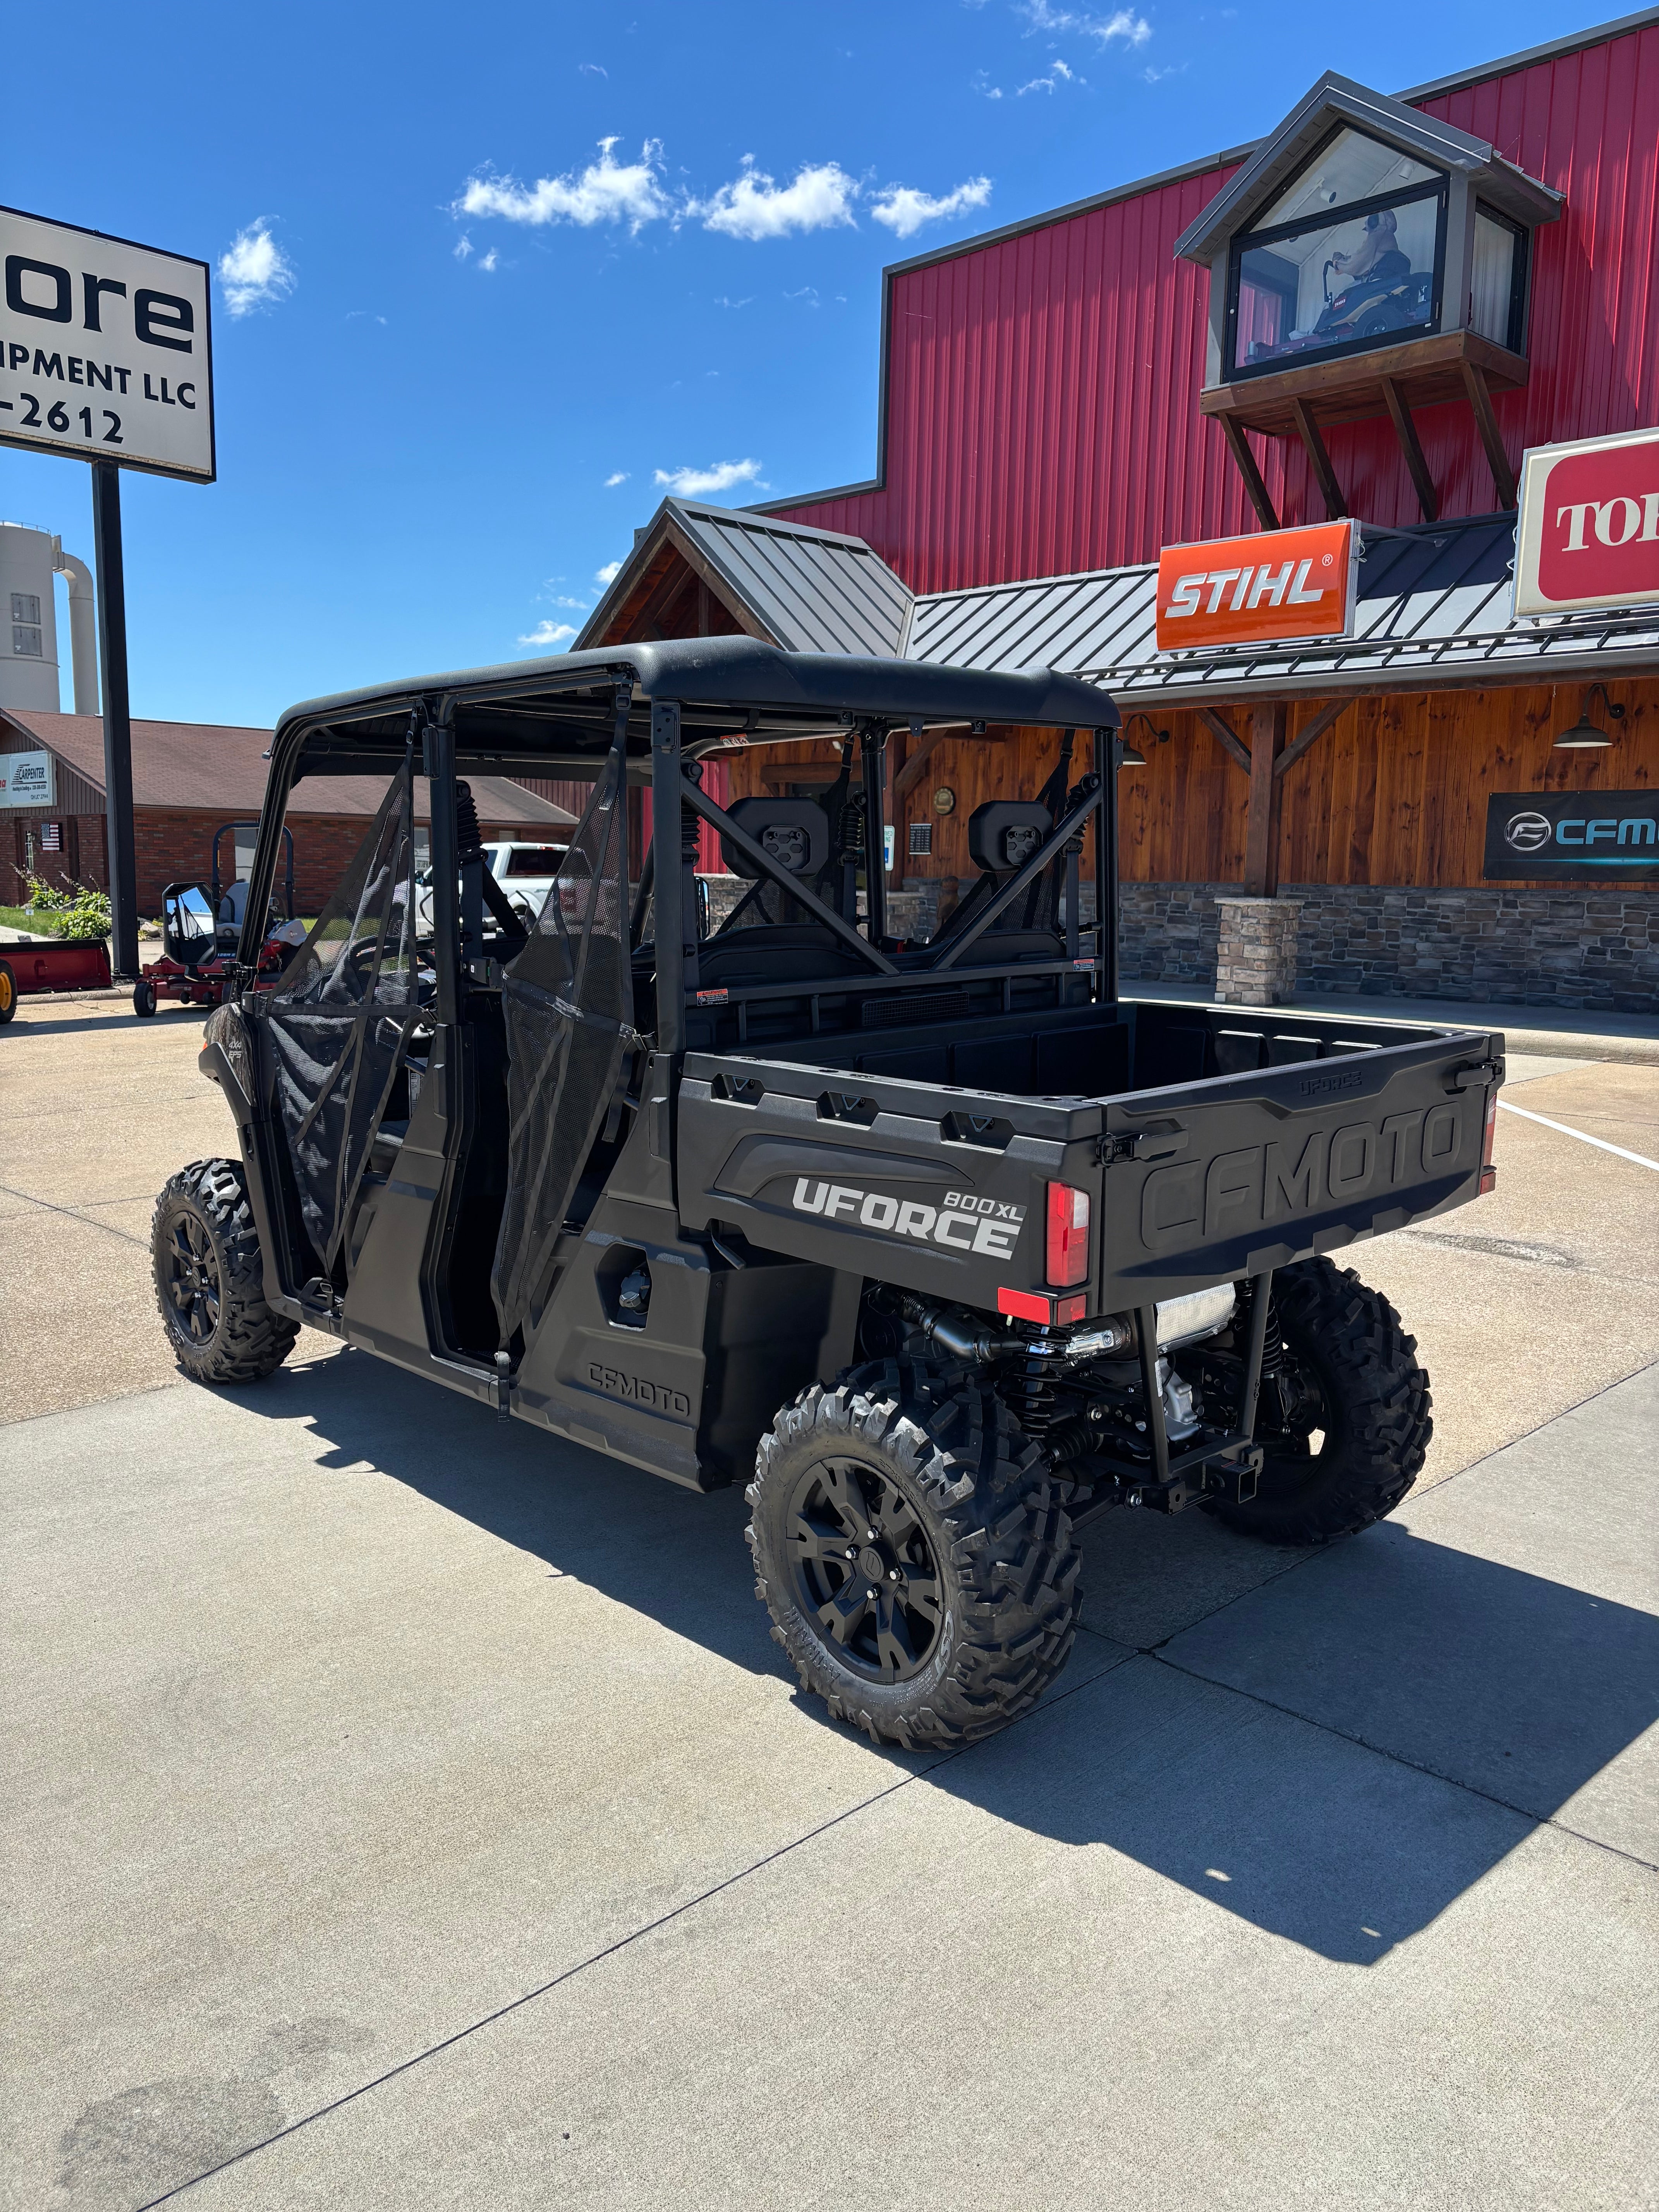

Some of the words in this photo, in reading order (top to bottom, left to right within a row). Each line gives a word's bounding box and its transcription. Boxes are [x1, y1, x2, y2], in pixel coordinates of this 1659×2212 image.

[5, 254, 194, 354] ore
[144, 373, 196, 409] LLC
[1164, 558, 1324, 618] STIHL
[19, 767, 45, 780] CARPENTER
[1556, 818, 1659, 845] CFM
[1299, 1071, 1362, 1097] UFORCE
[1141, 1101, 1463, 1250] CFMOTO
[792, 1177, 1021, 1260] UFORCE
[588, 1363, 690, 1417] CFMOTO
[934, 1609, 955, 1683] CST
